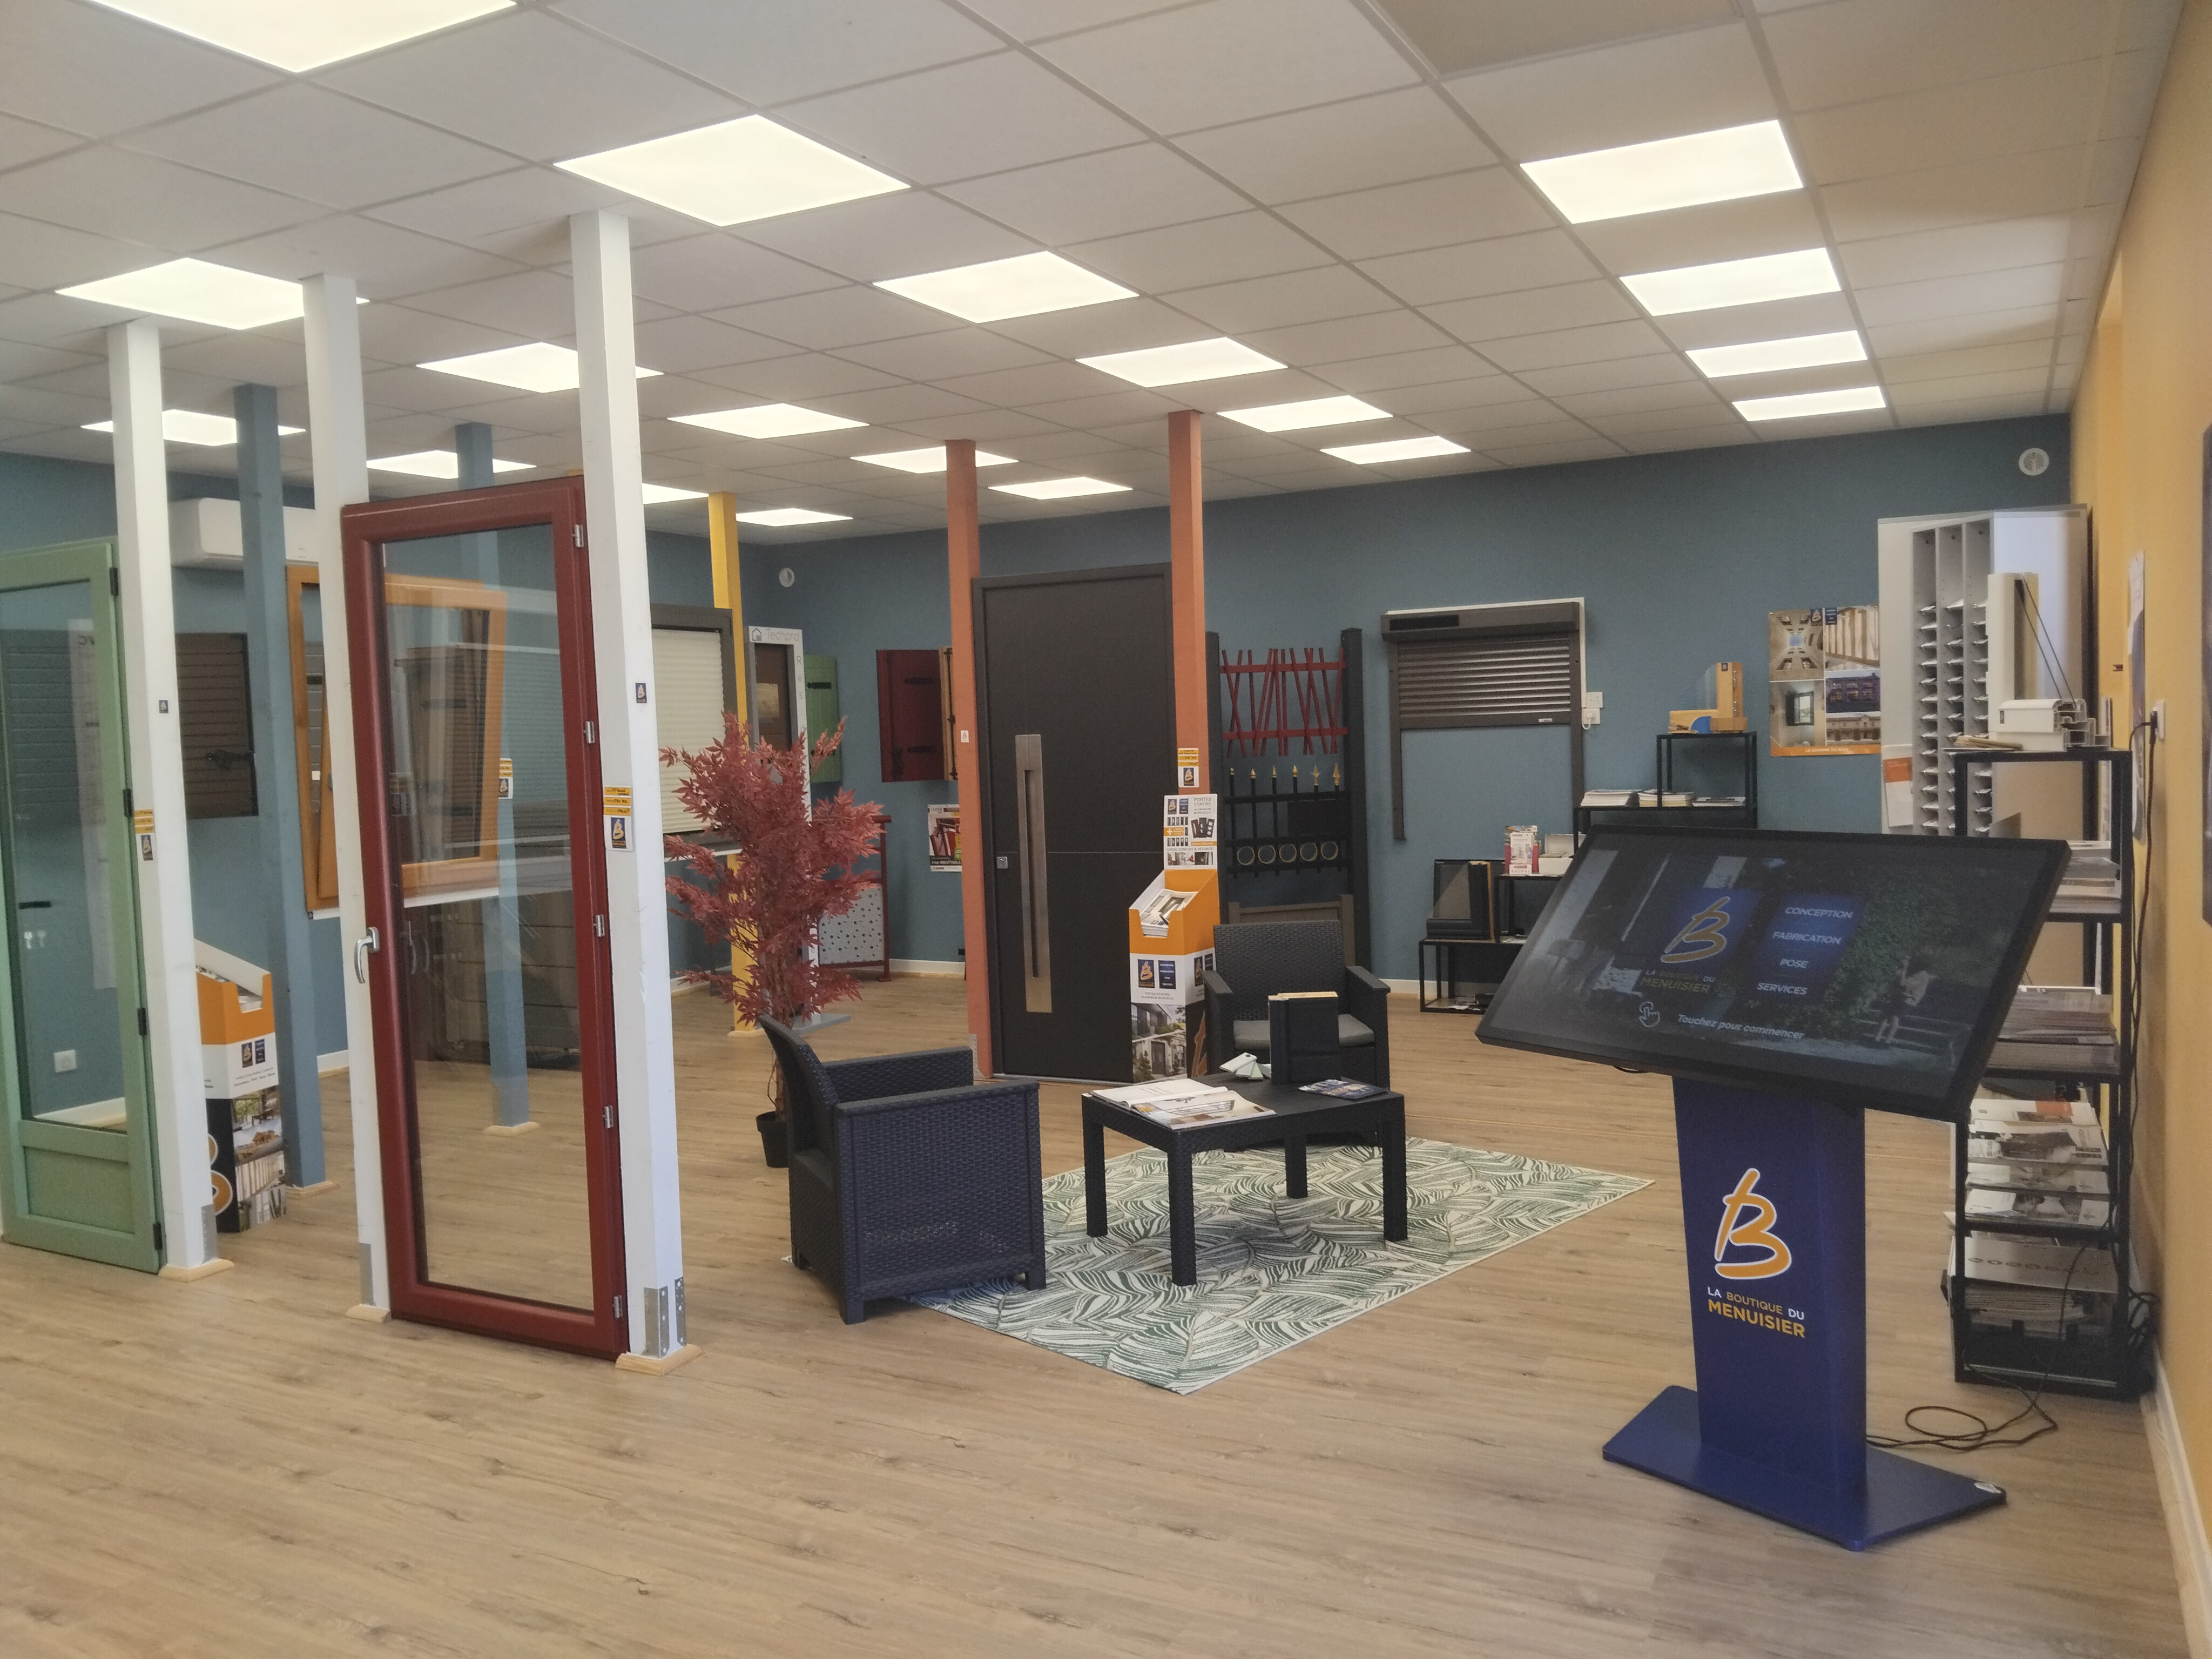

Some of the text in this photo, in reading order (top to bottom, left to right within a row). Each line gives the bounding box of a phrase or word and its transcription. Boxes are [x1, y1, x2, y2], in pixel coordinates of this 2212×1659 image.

[766, 629, 799, 643] Techpro
[1785, 907, 1853, 919] CONCEPTION
[1772, 931, 1842, 944] FABRICATION
[1779, 959, 1809, 968] POSE
[1641, 977, 1711, 993] MENUISIER
[1757, 982, 1808, 995] SERVICES
[1678, 1014, 1805, 1039] Touchez pour commencer
[1714, 1168, 1792, 1279] B
[1707, 1286, 1805, 1320] LA BOUTIQUE DU
[1708, 1298, 1805, 1338] MENUISIER
